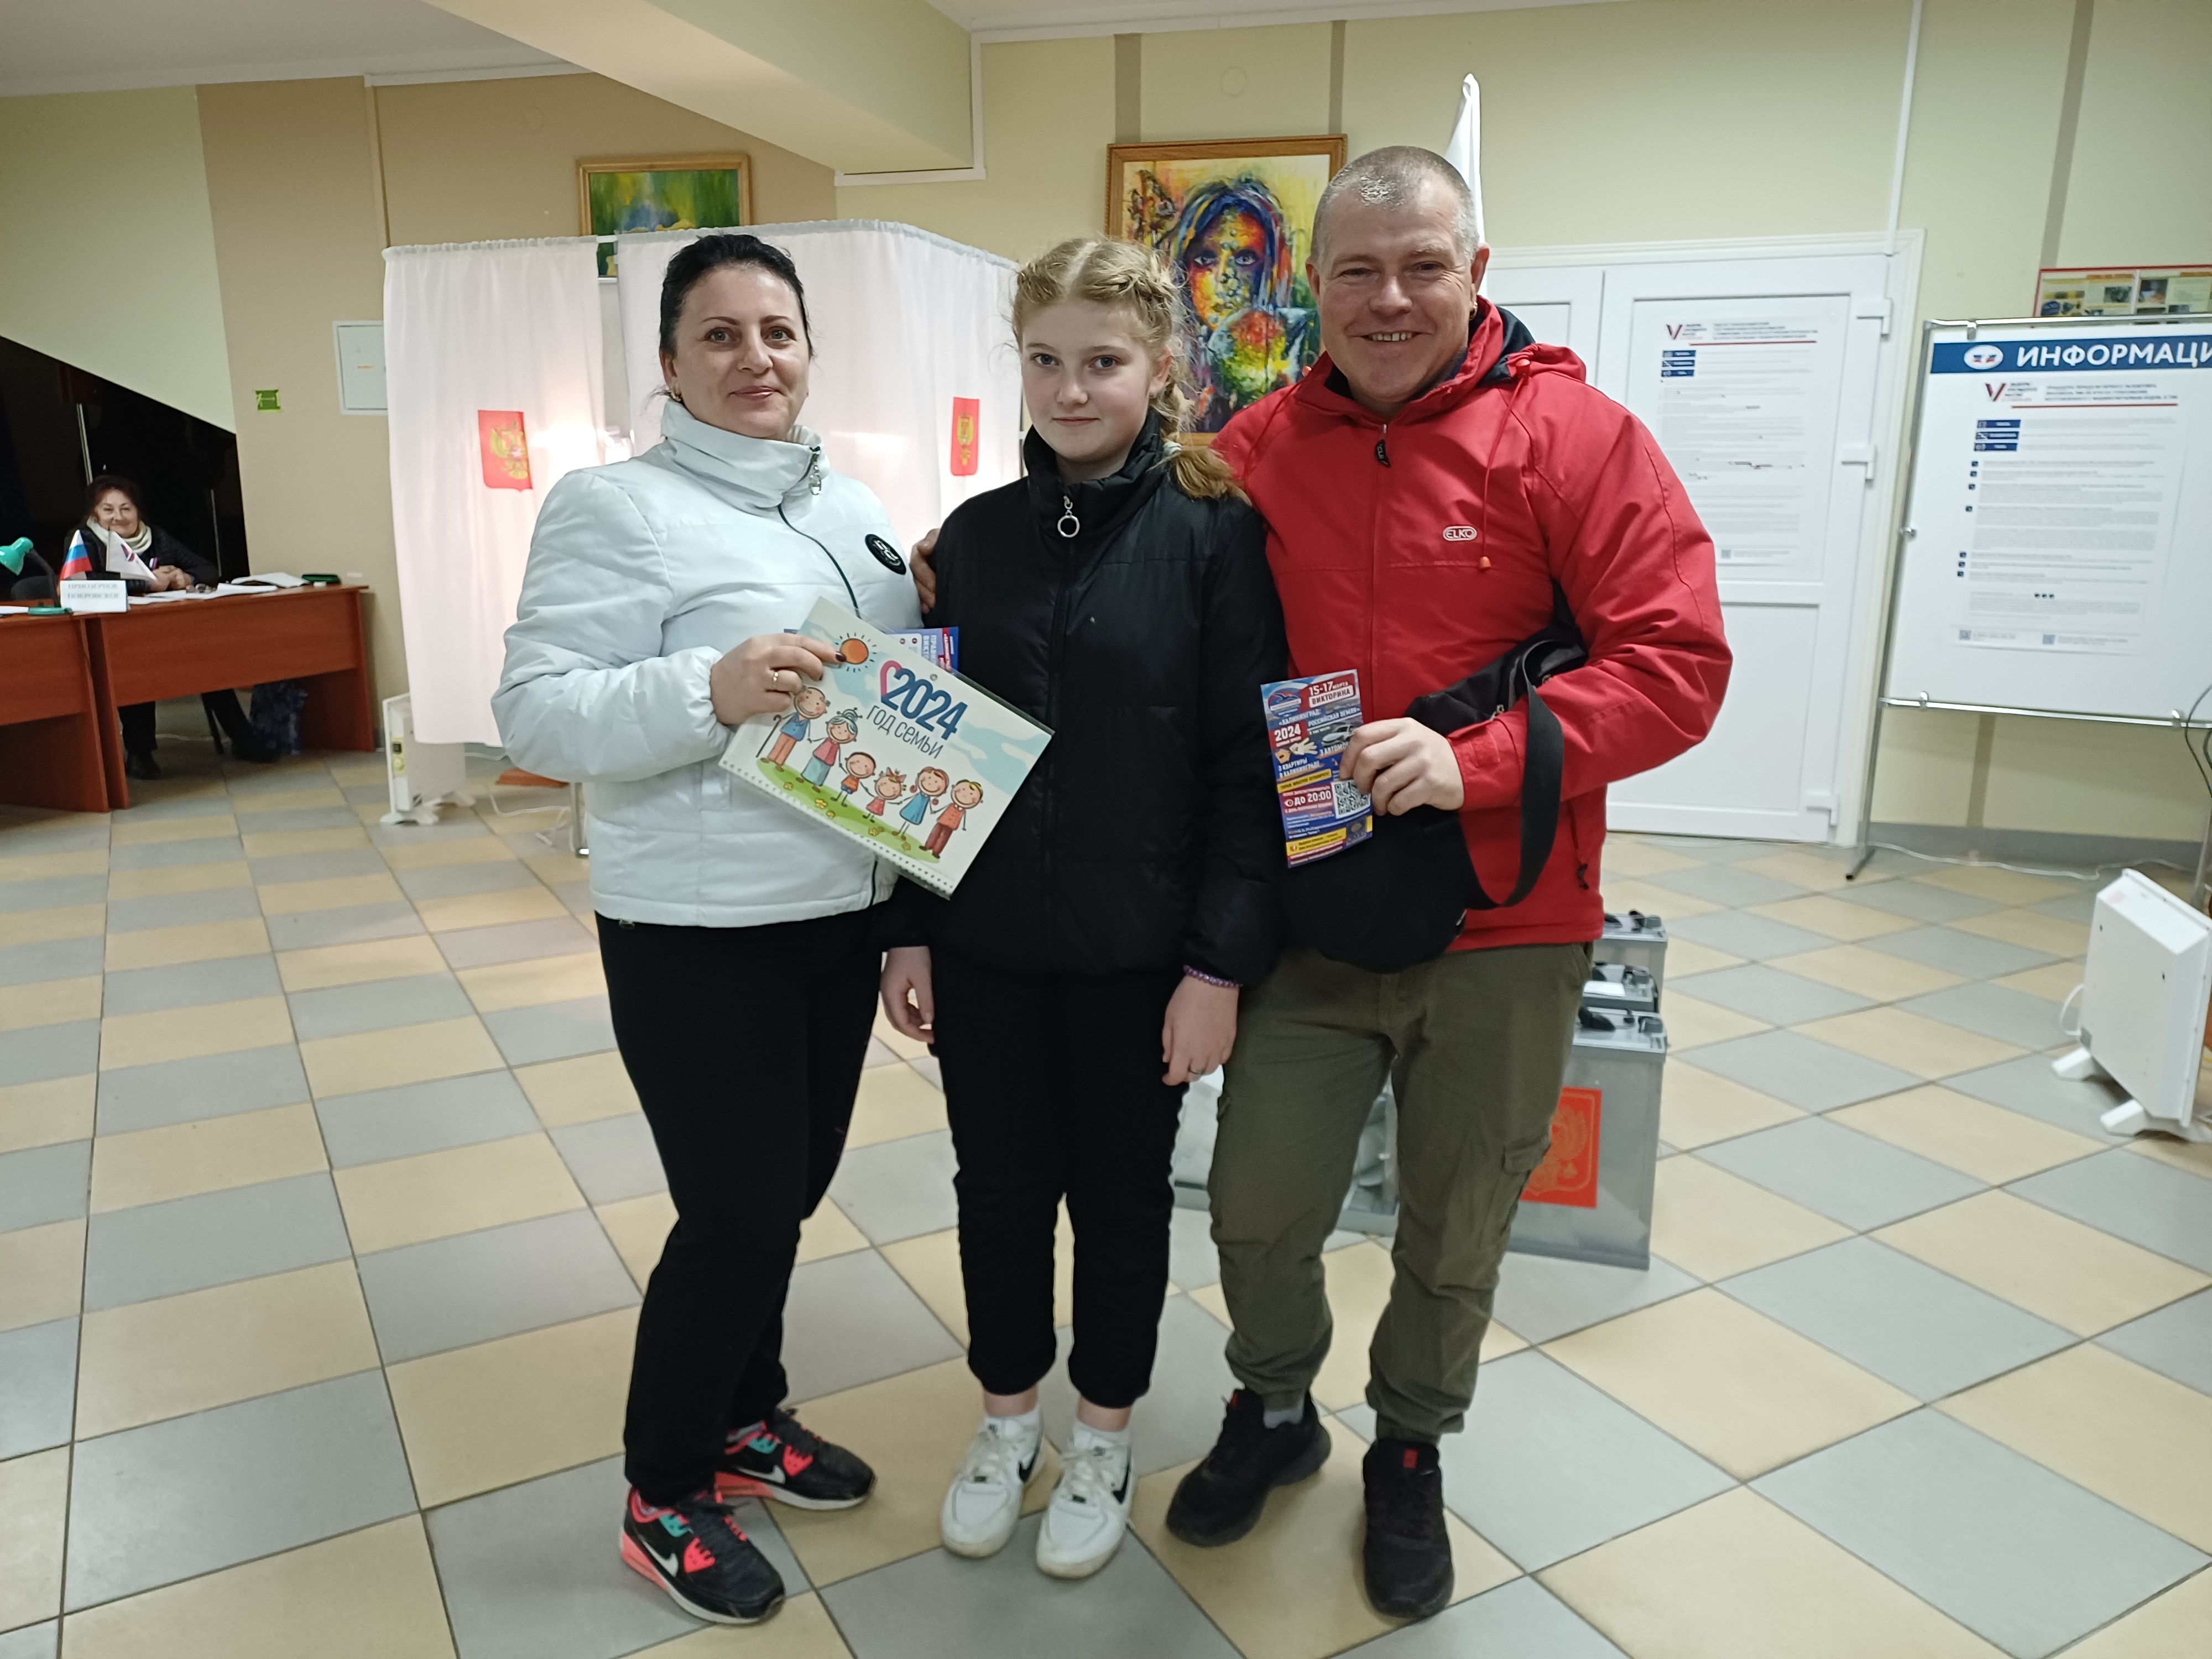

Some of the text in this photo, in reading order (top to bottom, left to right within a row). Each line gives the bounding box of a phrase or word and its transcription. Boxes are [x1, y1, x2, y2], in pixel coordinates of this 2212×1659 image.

[1445, 529, 1474, 539] ELKO
[1308, 681, 1334, 696] 15-17
[1312, 688, 1350, 705] ВИКТОРИНА
[880, 667, 968, 740] 2024
[866, 705, 896, 735] ГОД
[1274, 723, 1301, 742] 2024
[1294, 796, 1306, 806] ДО
[1307, 790, 1332, 803] 20:00
